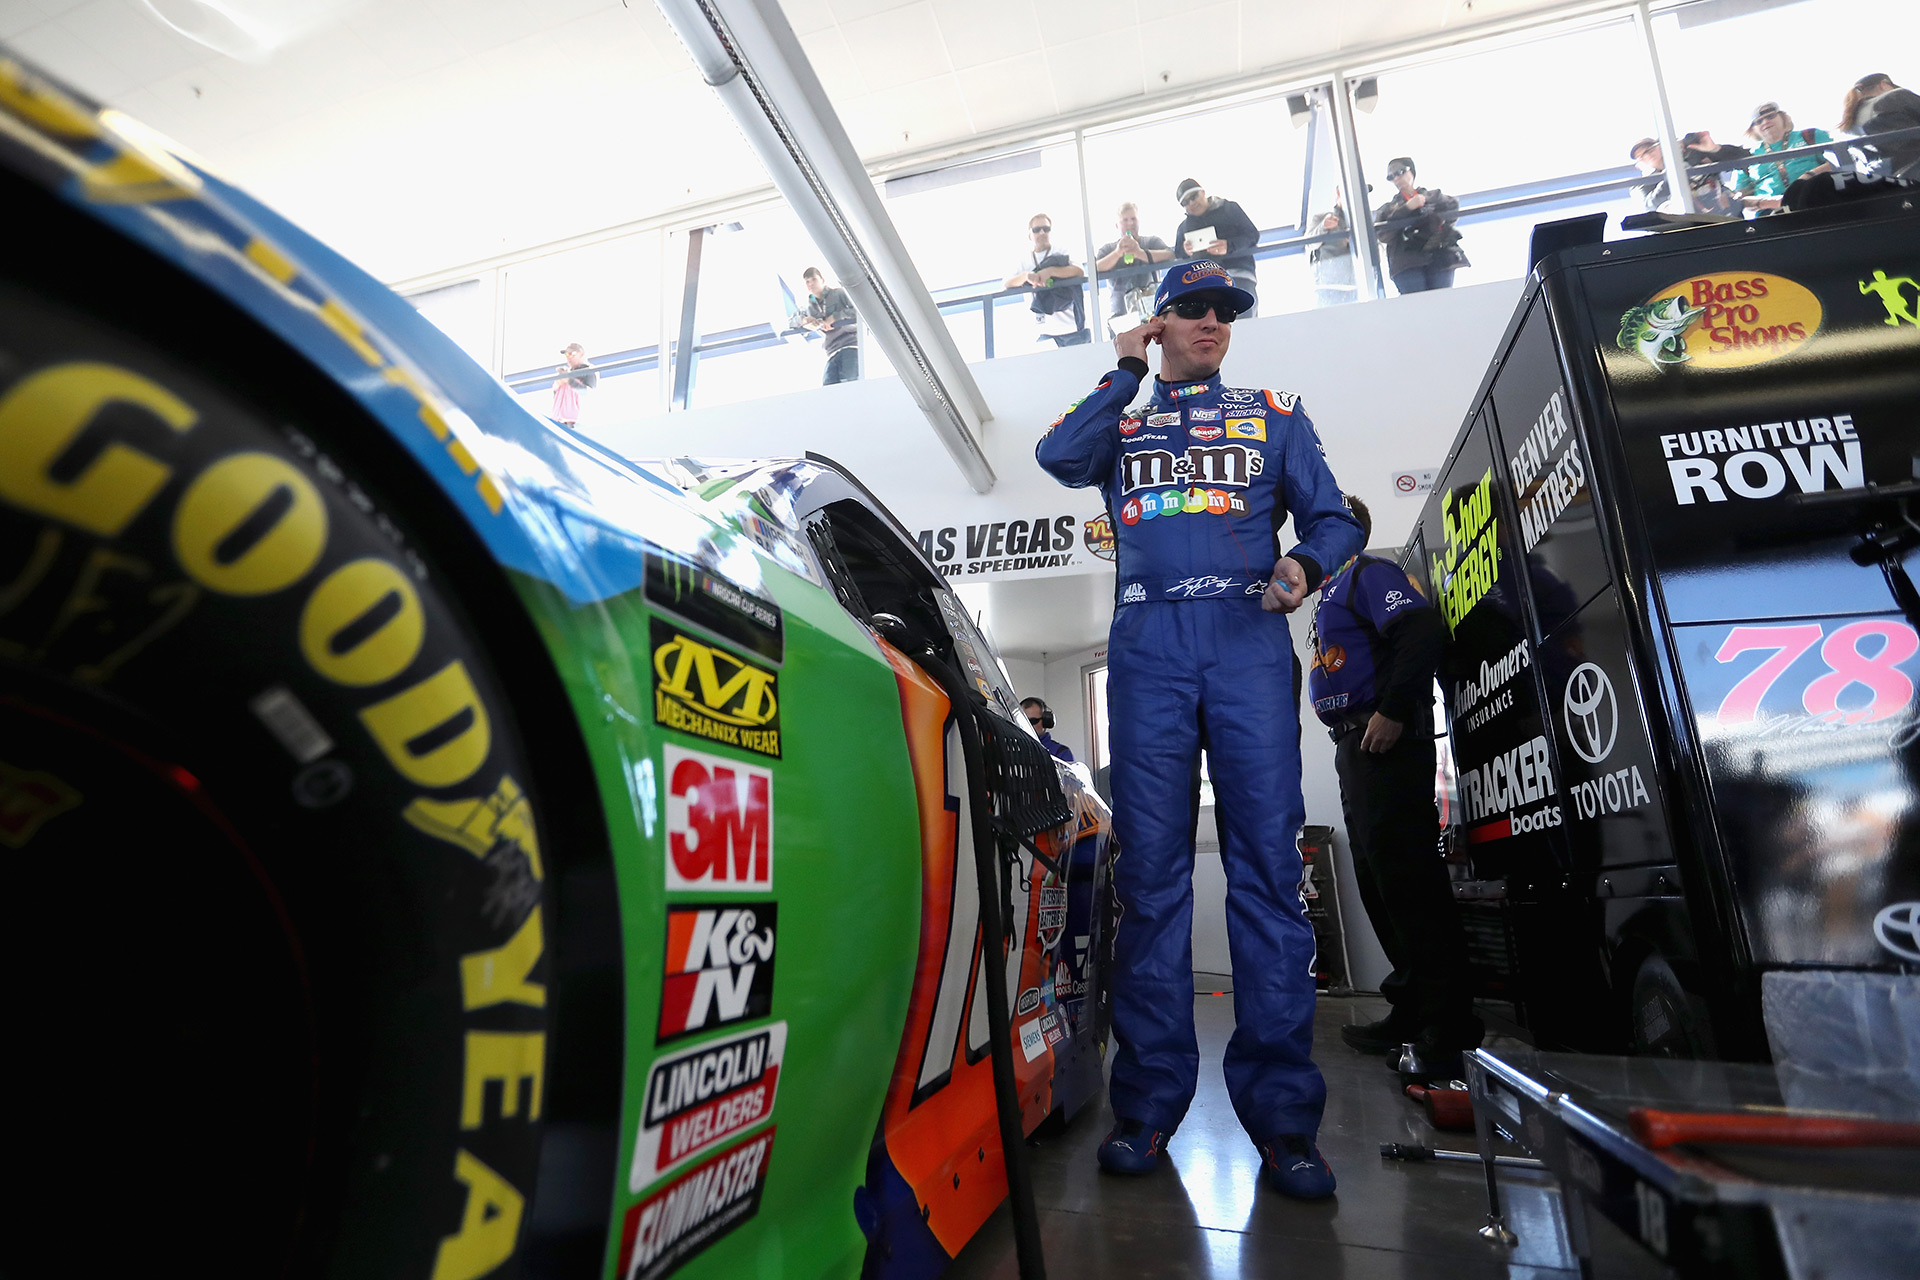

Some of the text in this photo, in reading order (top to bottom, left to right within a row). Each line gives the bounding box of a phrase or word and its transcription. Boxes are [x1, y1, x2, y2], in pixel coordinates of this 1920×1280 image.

[1690, 278, 1768, 307] Bass
[1701, 303, 1759, 329] Pro
[1709, 321, 1807, 354] Shops
[1511, 391, 1568, 499] DENVER
[1660, 415, 1857, 459] FURNITURE
[1666, 440, 1866, 506] ROW
[1519, 439, 1585, 554] MATTRESS
[966, 515, 1075, 558] VEGAS
[1442, 466, 1492, 572] 5-hour
[967, 553, 1074, 575] SPEEDWAY
[1446, 517, 1499, 630] ENERGY
[712, 582, 778, 628] NASCAR CUP SERIES
[1123, 582, 1146, 598] MAC
[1385, 598, 1413, 613] TOYOTA
[1452, 638, 1531, 722] Auto-Owners
[1714, 620, 1920, 727] 78
[656, 690, 739, 745] MECHANIX
[1315, 693, 1349, 713] SNICKERS
[1466, 689, 1514, 734] INSURANCE
[740, 729, 779, 756] WEAR
[1460, 734, 1557, 823] TRACKER
[1570, 765, 1650, 821] TOYOTA
[670, 758, 768, 882] 3M
[1510, 805, 1562, 836] boats
[1055, 961, 1072, 987] MAC
[1055, 984, 1072, 997] TOOLS
[1023, 1029, 1041, 1050] SIEMENS
[1040, 1014, 1058, 1033] LINCOLN
[650, 1036, 766, 1123] LINCOLN
[669, 1085, 766, 1160] WELDERS
